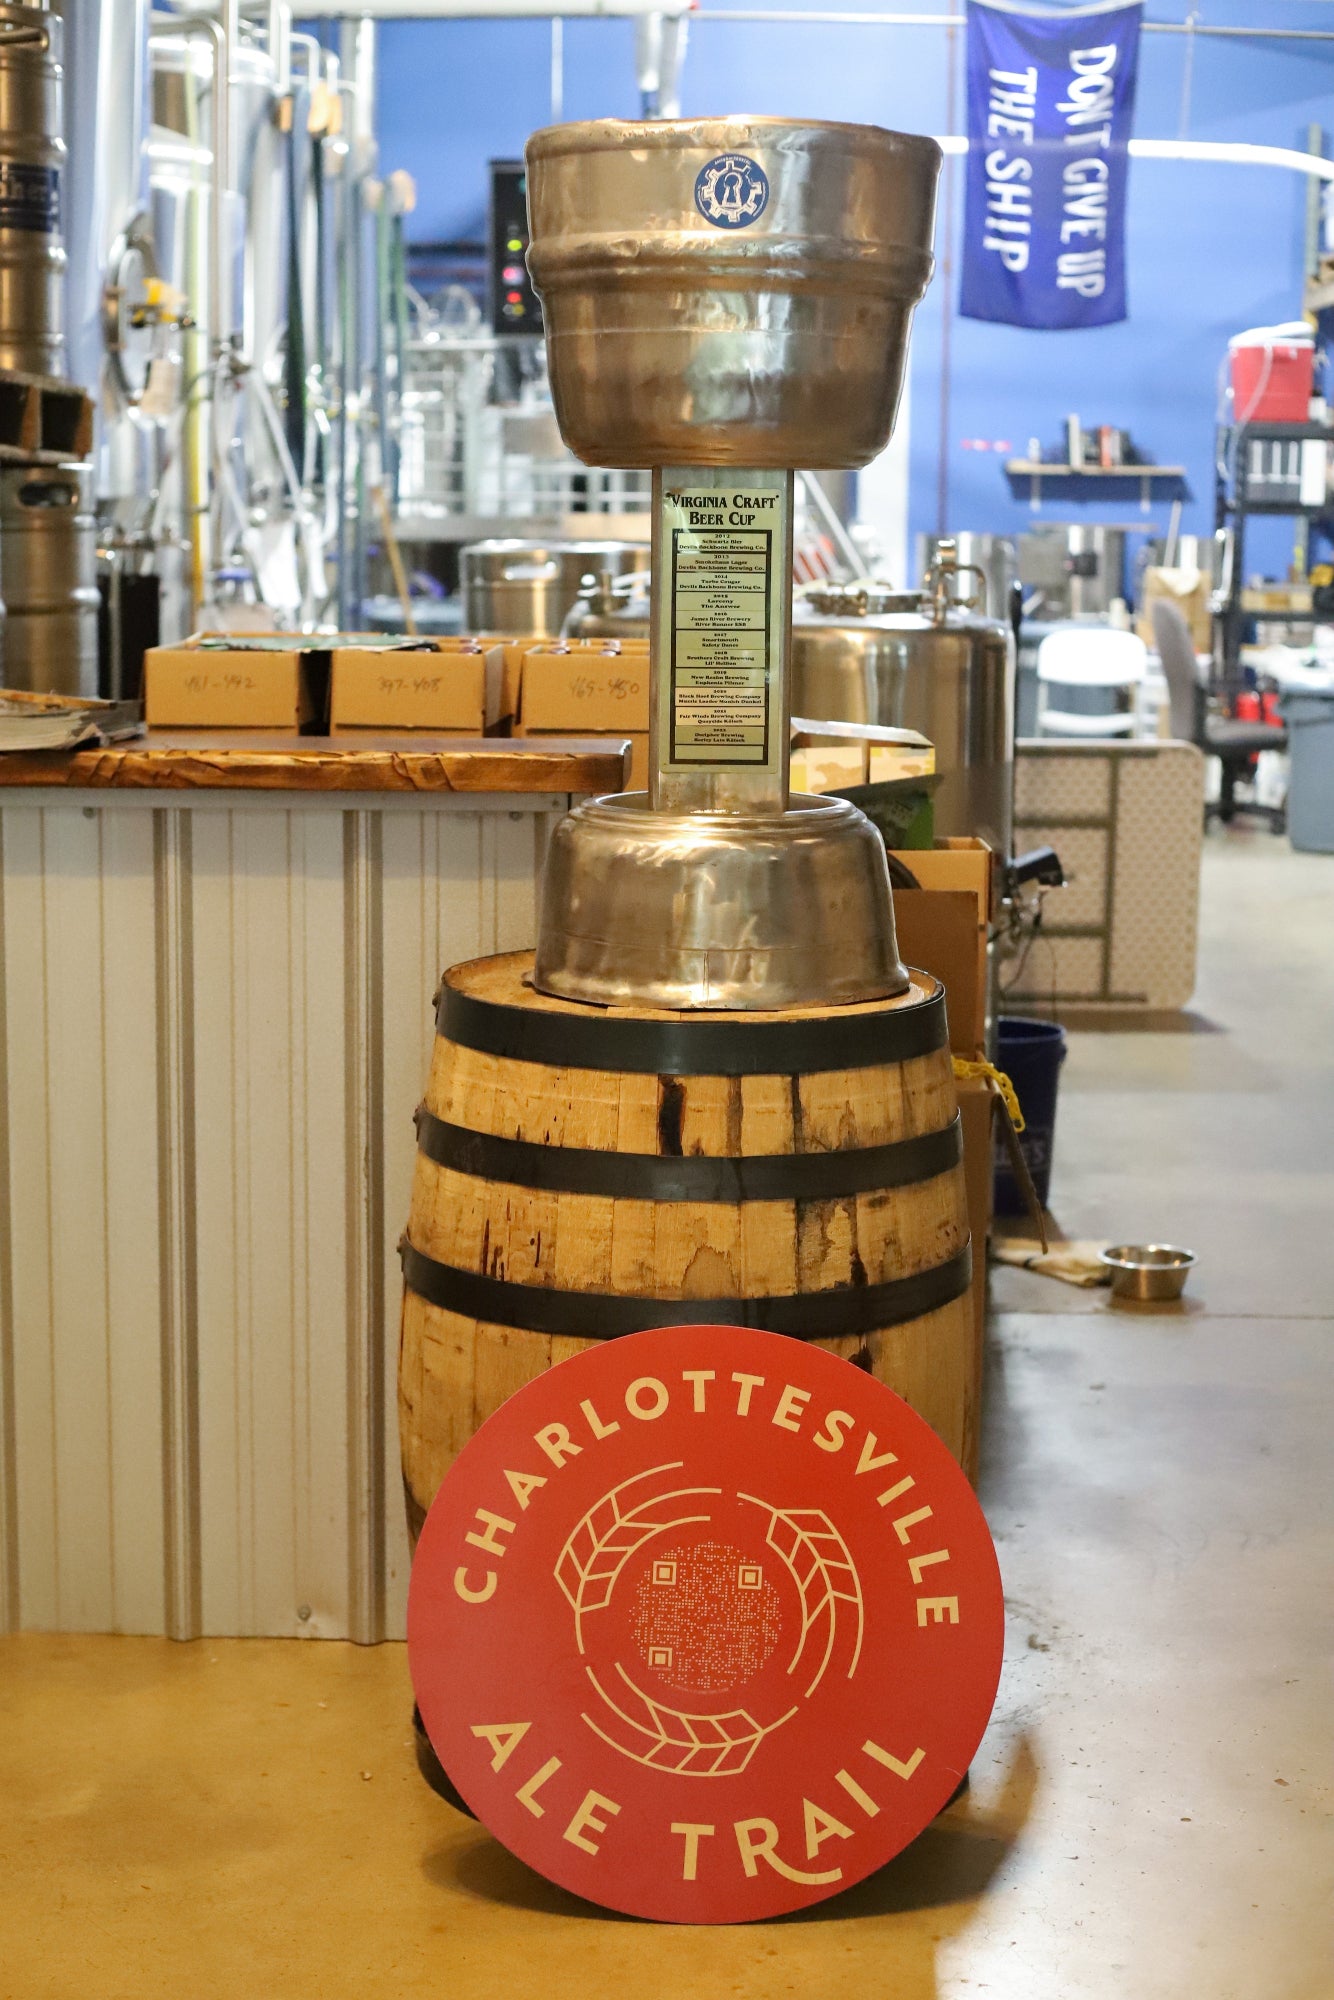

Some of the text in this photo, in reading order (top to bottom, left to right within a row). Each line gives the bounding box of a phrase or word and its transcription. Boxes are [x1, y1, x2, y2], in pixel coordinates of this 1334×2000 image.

[982, 66, 1038, 273] THE SHIP
[1060, 157, 1109, 244] GIVE
[1056, 248, 1106, 298] UP
[454, 1370, 960, 1627] CHARLOTTESVILLE
[471, 1721, 926, 1885] ALE TRAIL
